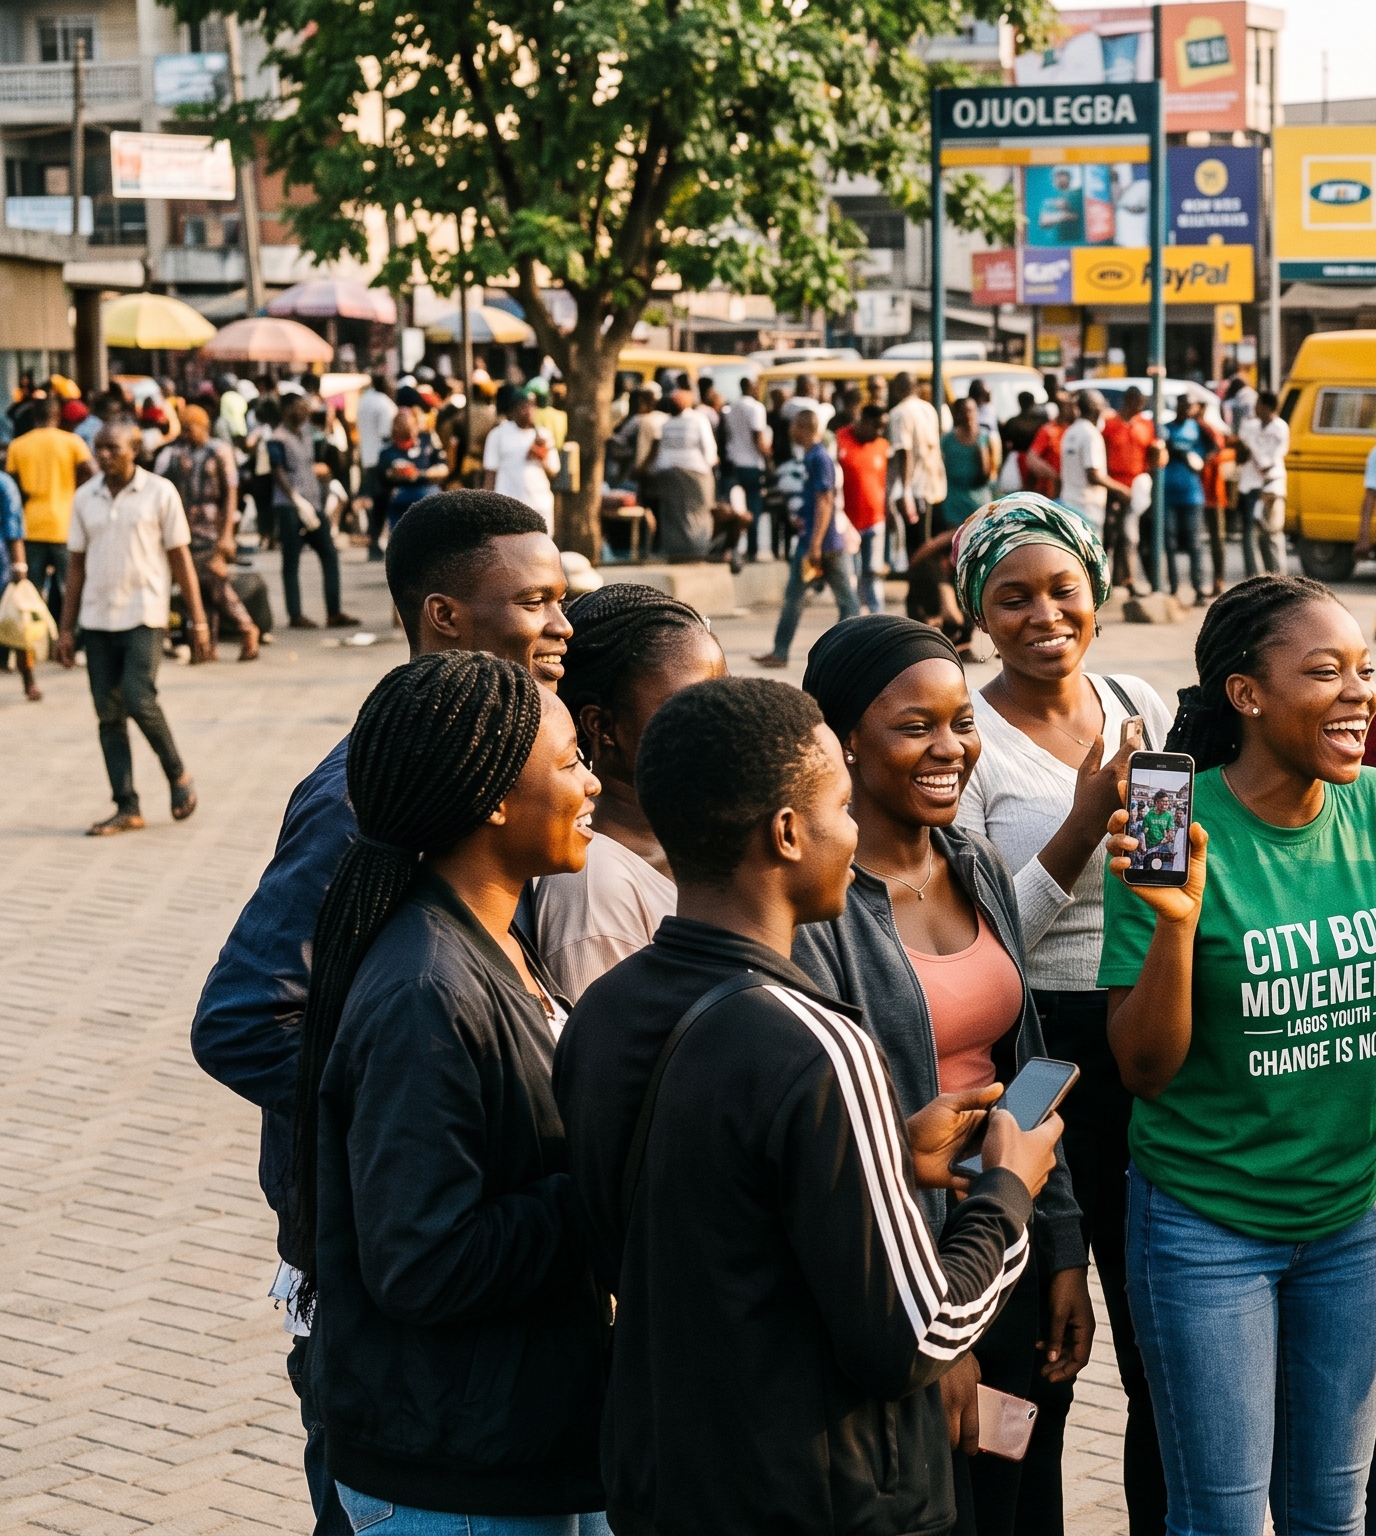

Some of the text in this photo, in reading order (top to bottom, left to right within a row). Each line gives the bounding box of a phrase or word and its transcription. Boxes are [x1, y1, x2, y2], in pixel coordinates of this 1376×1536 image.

[952, 94, 1137, 129] OJUOLEGBA
[1243, 919, 1320, 976] CITY
[1287, 1005, 1371, 1037] LAGOS YOUTH
[1249, 1040, 1330, 1077] CHANGE
[1335, 1037, 1353, 1063] IS
